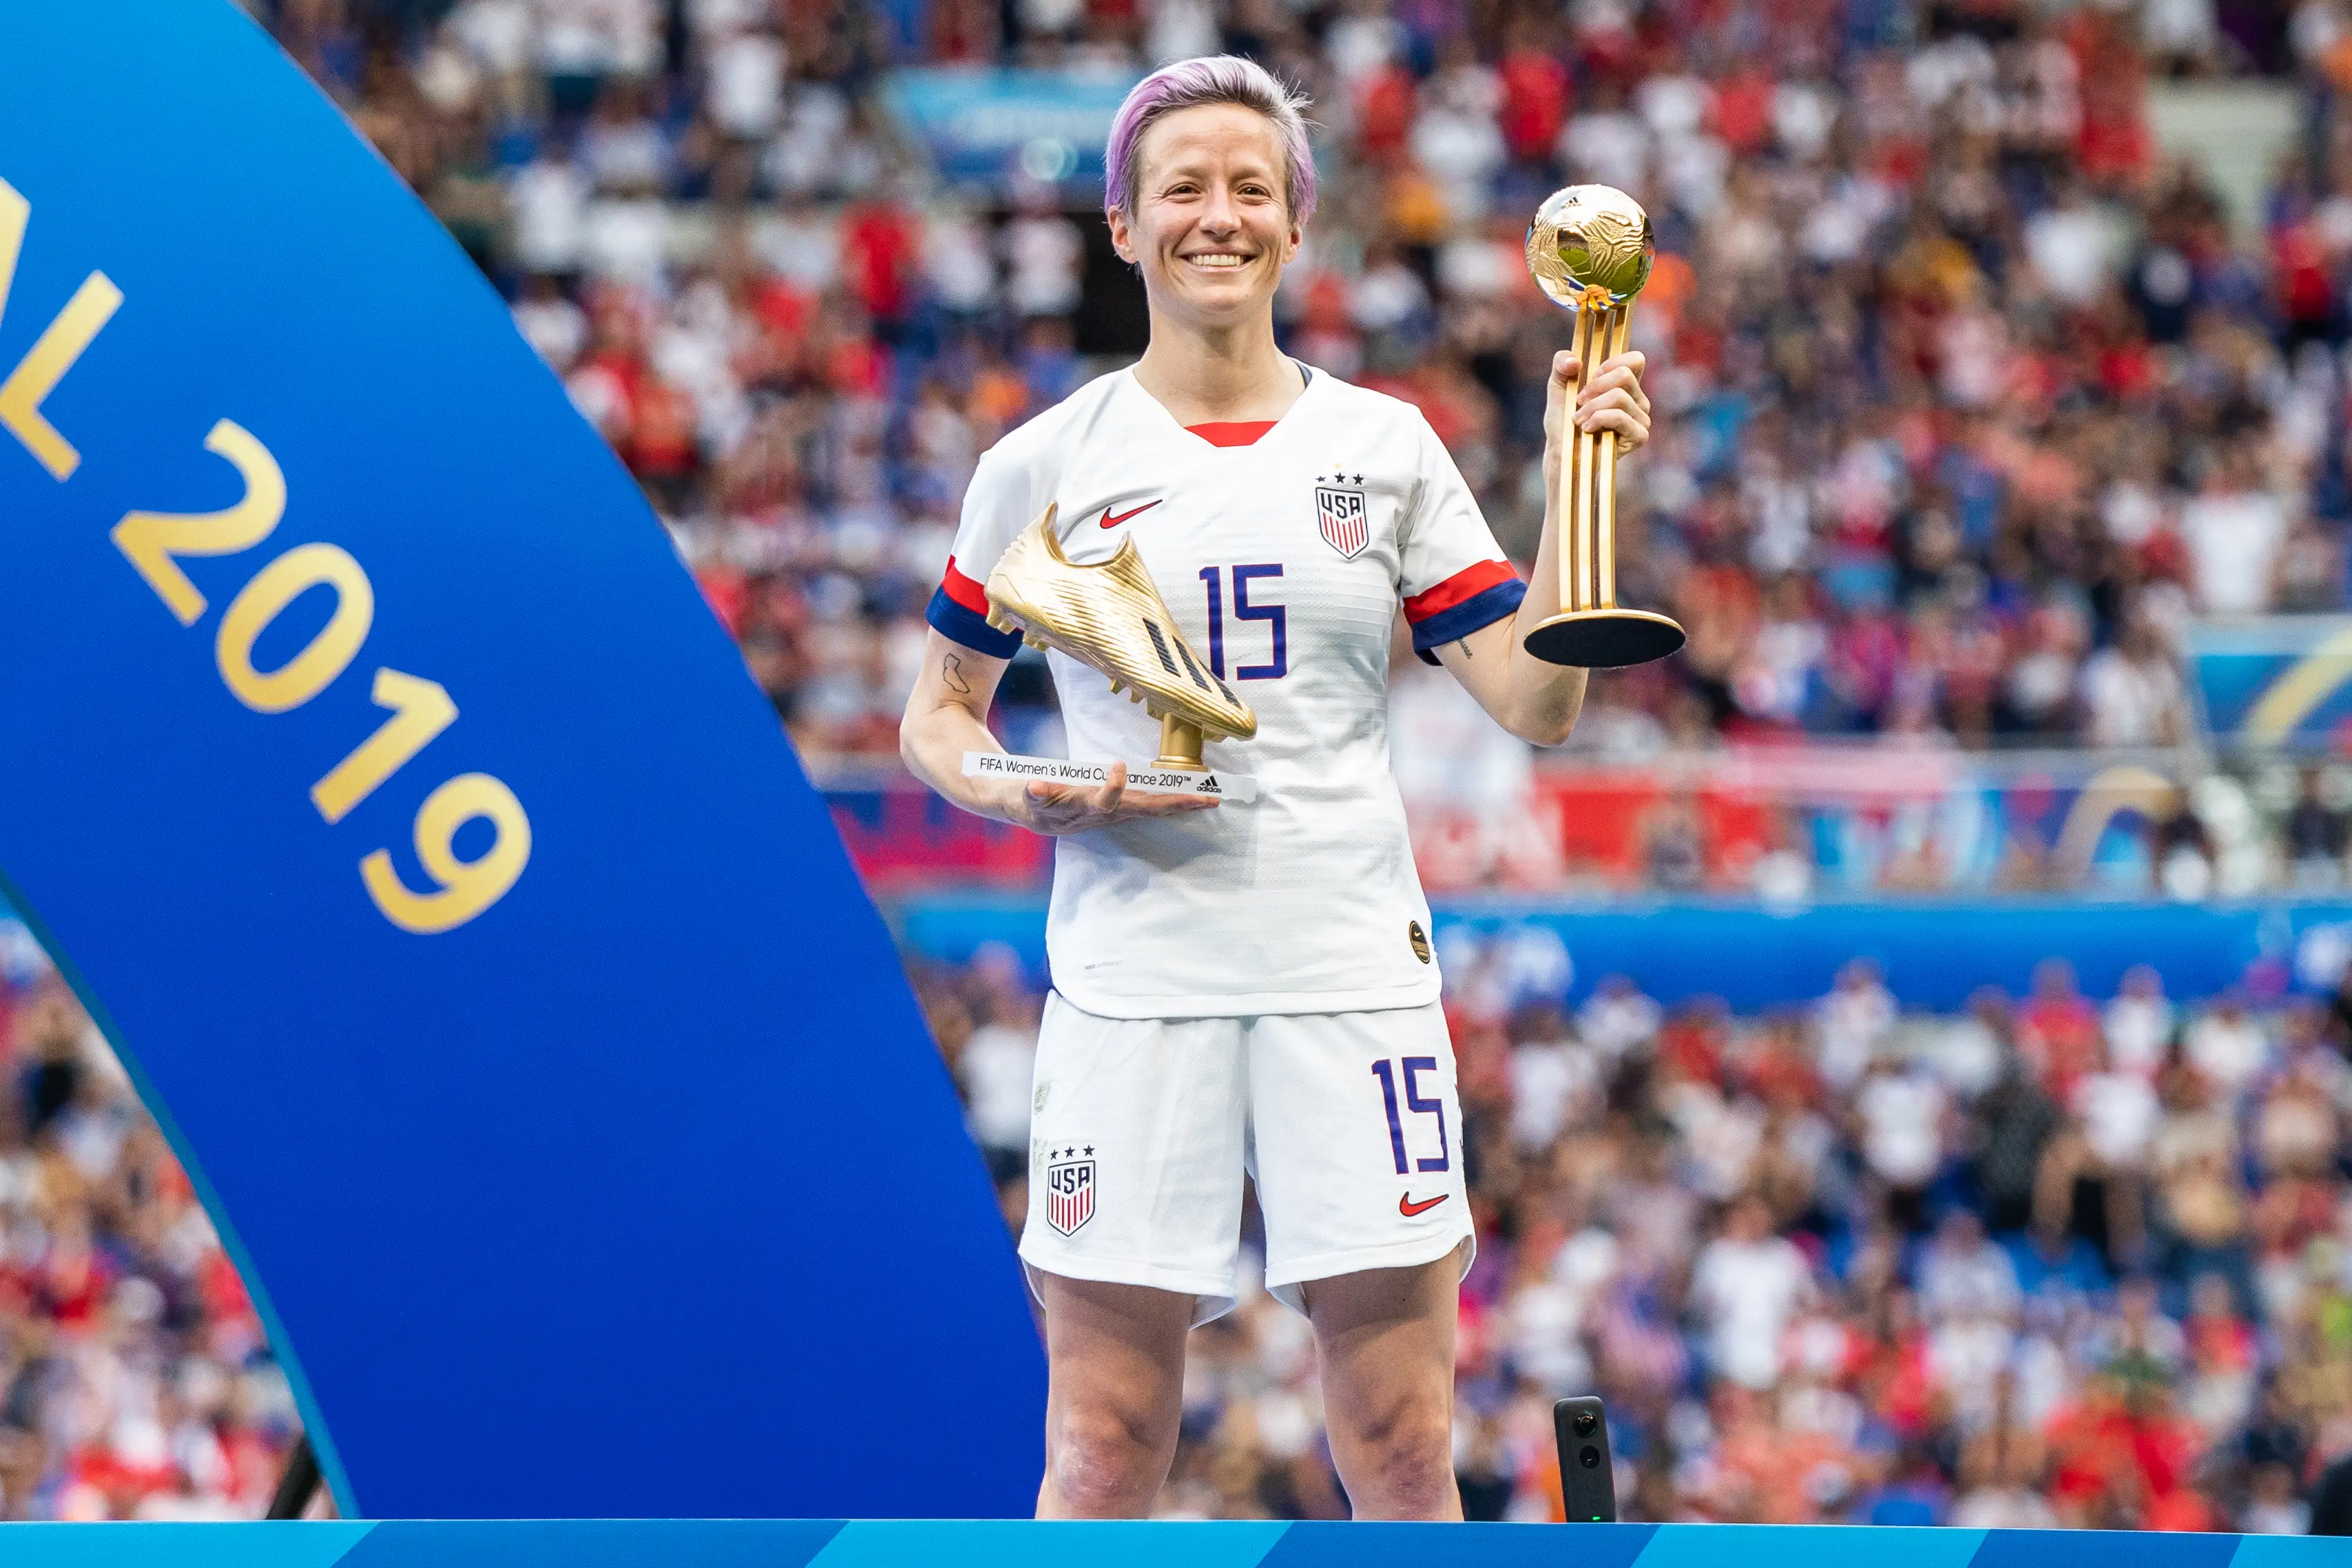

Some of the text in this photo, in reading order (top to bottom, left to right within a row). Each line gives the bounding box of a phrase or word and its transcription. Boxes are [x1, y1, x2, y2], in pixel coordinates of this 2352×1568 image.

[1320, 492, 1361, 520] USA
[0, 176, 532, 934] L 2019
[1199, 563, 1287, 681] 15
[979, 757, 1003, 771] FIFA
[1006, 760, 1057, 777] Women's
[1059, 764, 1091, 780] World
[1092, 767, 1107, 781] Cu
[1126, 773, 1157, 785] rance
[1371, 1056, 1450, 1175] 15
[1051, 1166, 1090, 1195] USA
